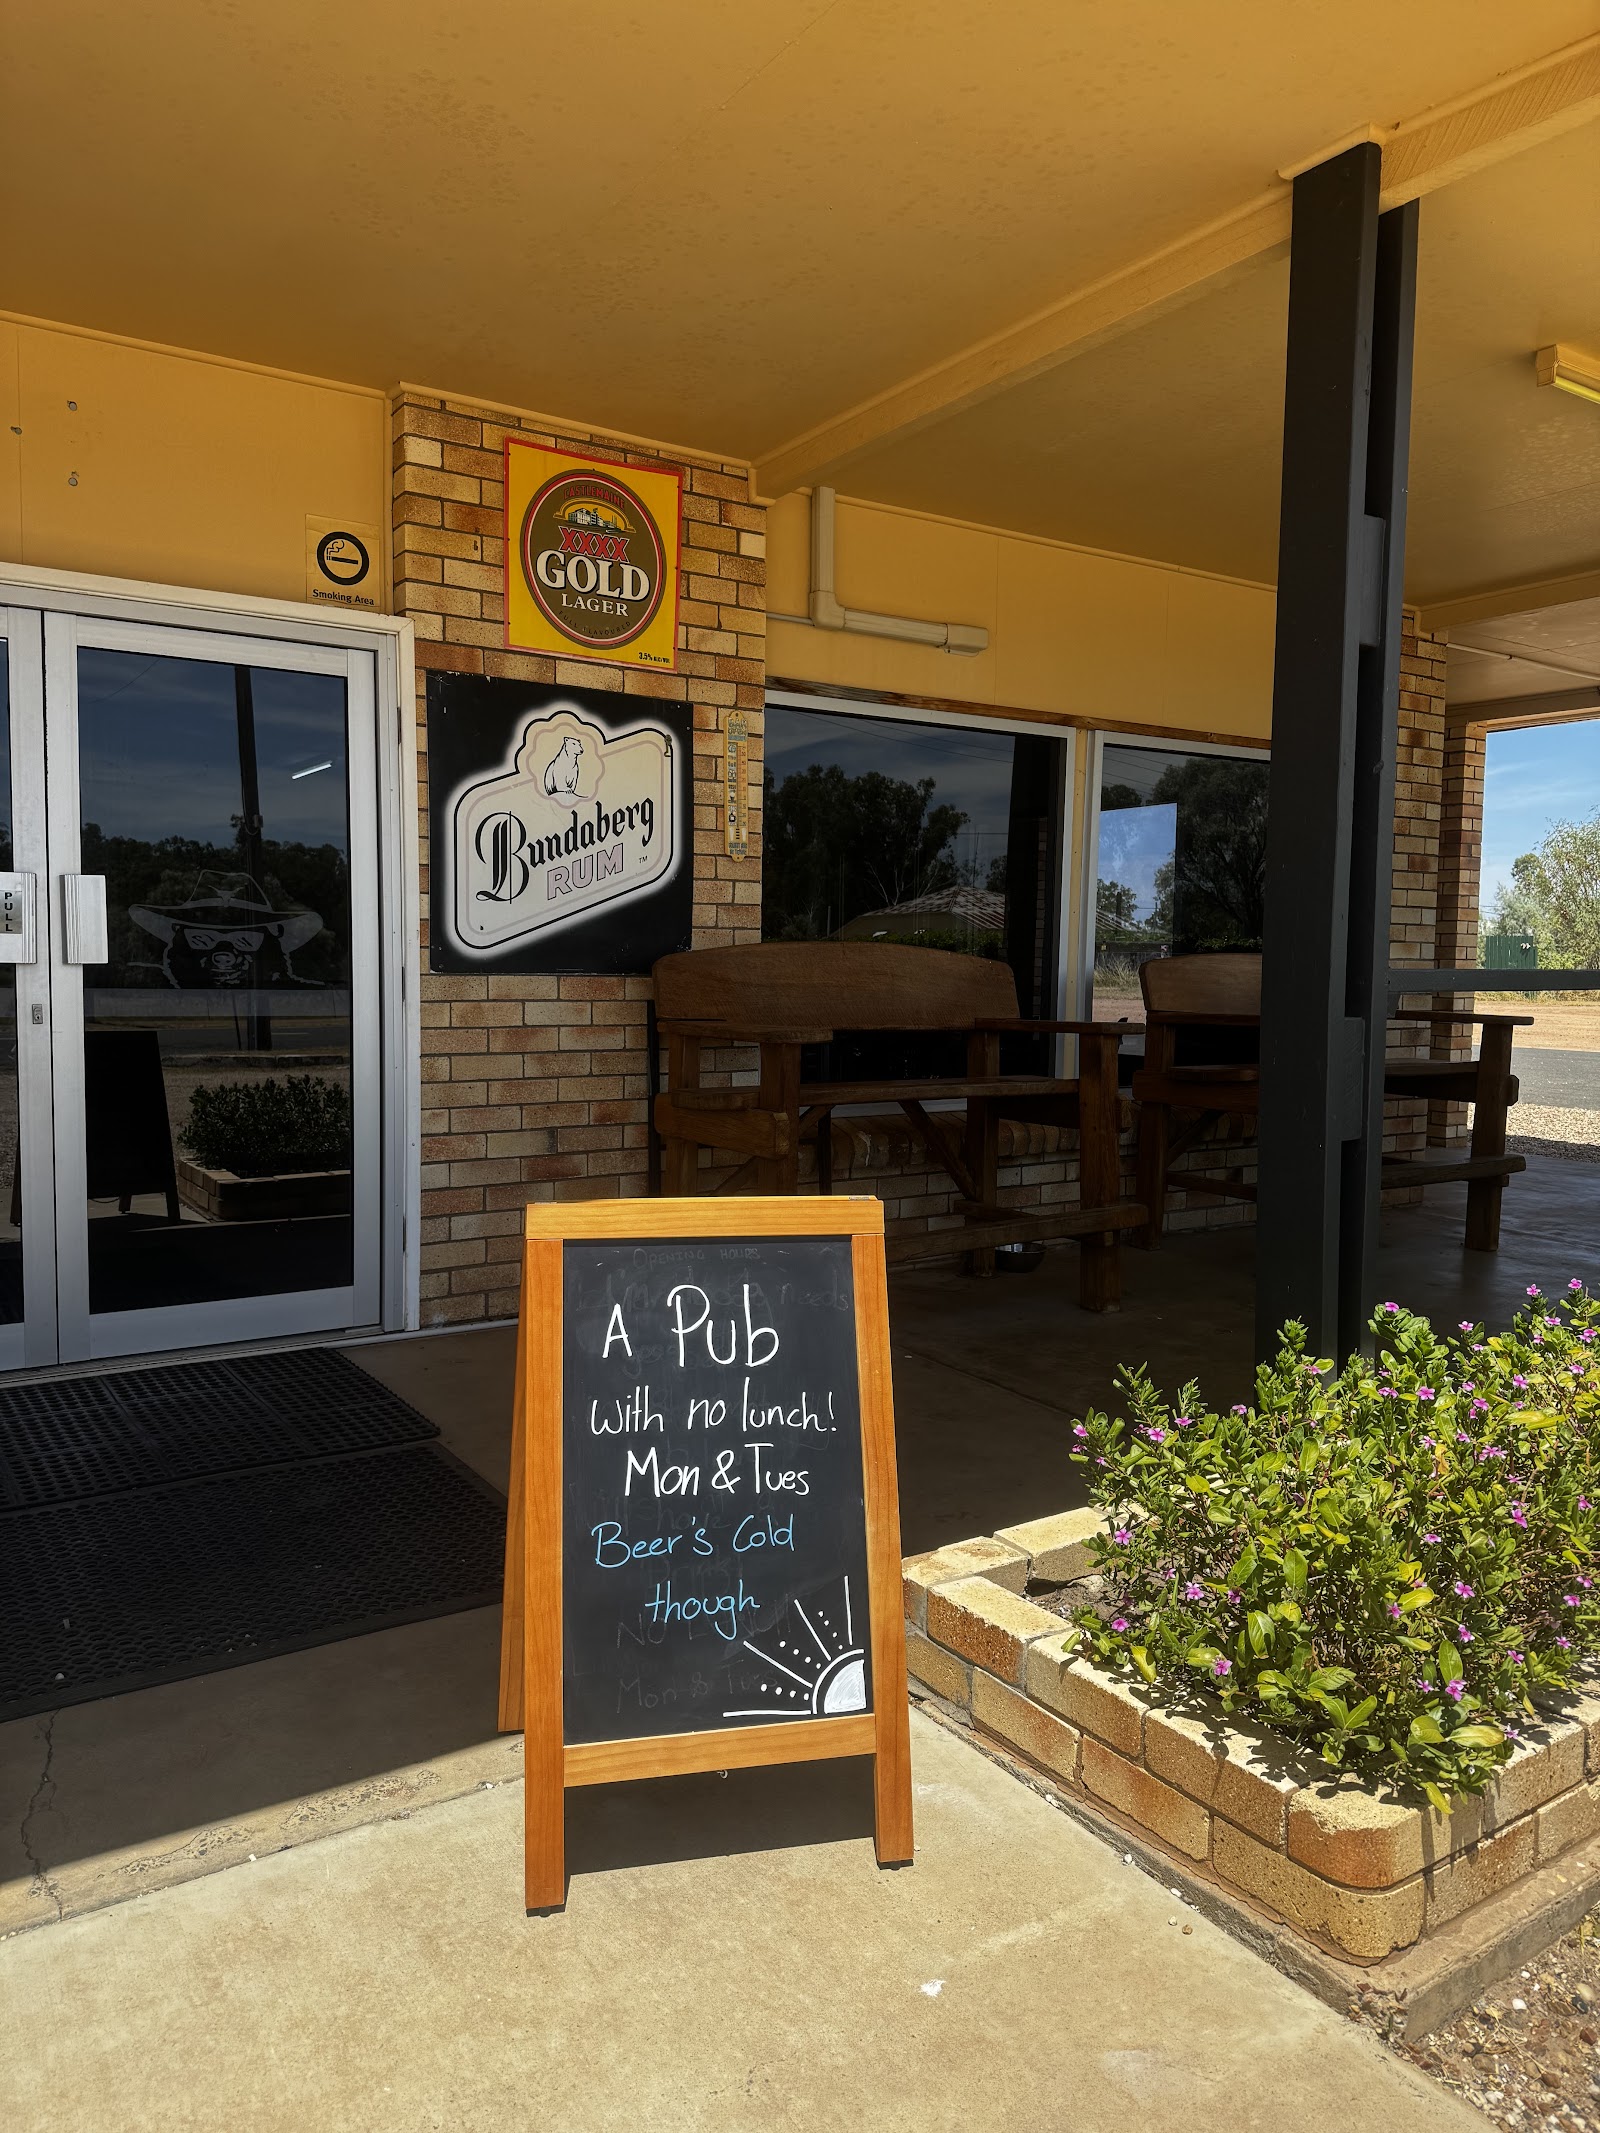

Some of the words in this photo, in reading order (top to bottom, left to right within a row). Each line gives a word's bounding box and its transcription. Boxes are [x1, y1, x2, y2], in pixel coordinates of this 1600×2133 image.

[564, 485, 625, 510] CASTLEMAINE
[558, 526, 630, 564] XXXX
[312, 589, 352, 604] Smoking
[354, 595, 375, 606] Area
[536, 550, 650, 602] GOLD
[561, 593, 629, 616] LAGER
[638, 651, 653, 661] 3.5%
[474, 797, 655, 905] Bundaberg
[547, 842, 625, 901] RUM
[4, 891, 13, 932] PULL
[602, 1303, 633, 1358] A
[667, 1283, 780, 1367] Pub
[687, 1398, 726, 1430] no
[742, 1376, 838, 1432] lunch!
[624, 1446, 701, 1498] Mon
[711, 1449, 741, 1494] &
[744, 1442, 811, 1496] Tues
[590, 1516, 714, 1569] Beer's
[732, 1512, 796, 1552] Cold
[644, 1578, 761, 1641] though
